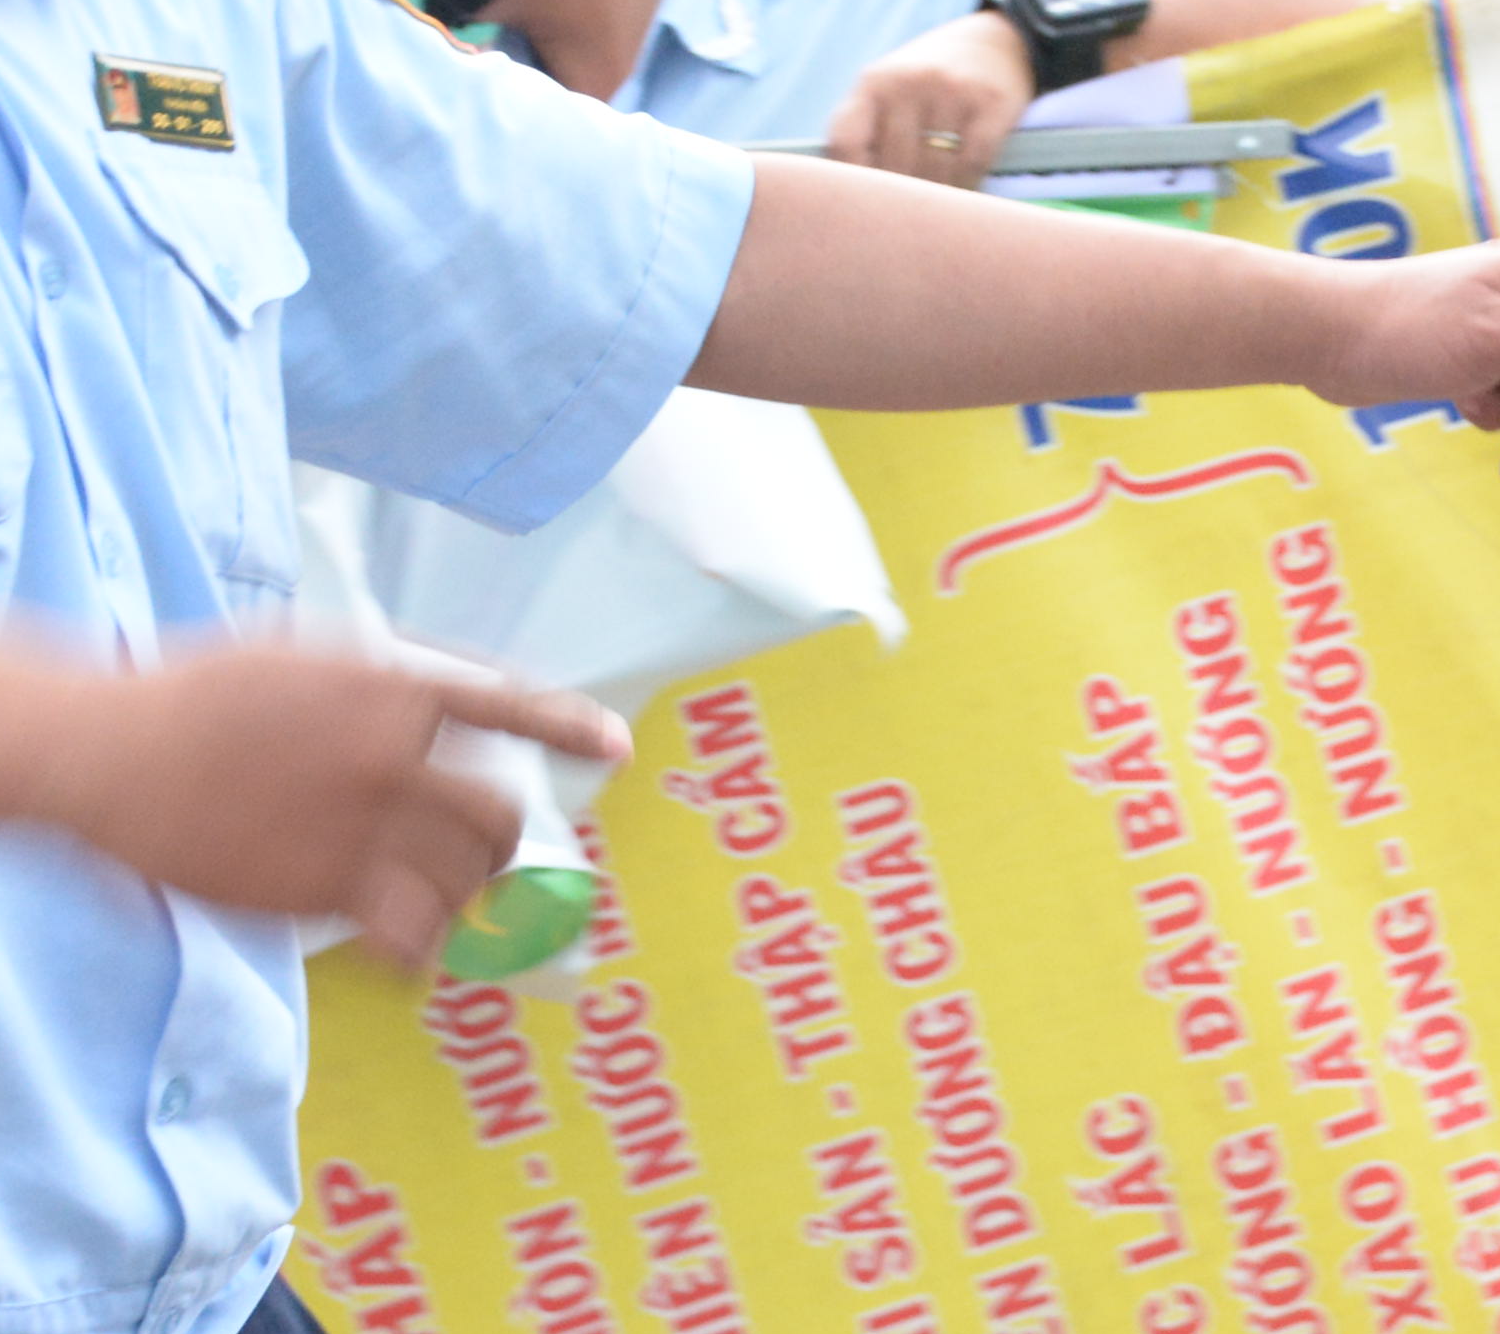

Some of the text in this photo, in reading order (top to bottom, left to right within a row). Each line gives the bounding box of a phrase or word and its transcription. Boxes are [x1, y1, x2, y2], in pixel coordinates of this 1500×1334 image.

[1073, 678, 1186, 853] BẮP
[1174, 596, 1308, 892] NƯỚNG
[1269, 525, 1403, 821] NƯỚNG
[738, 877, 850, 1076] THẬP
[840, 782, 955, 984] CHÂU
[434, 973, 547, 1141] NƯỚ
[577, 982, 694, 1188] NƯỚC
[1373, 894, 1490, 1134] HỒNG
[810, 1133, 913, 1286] SẢN
[905, 997, 1033, 1249] DƯƠNG
[1079, 1097, 1186, 1267] LẮC
